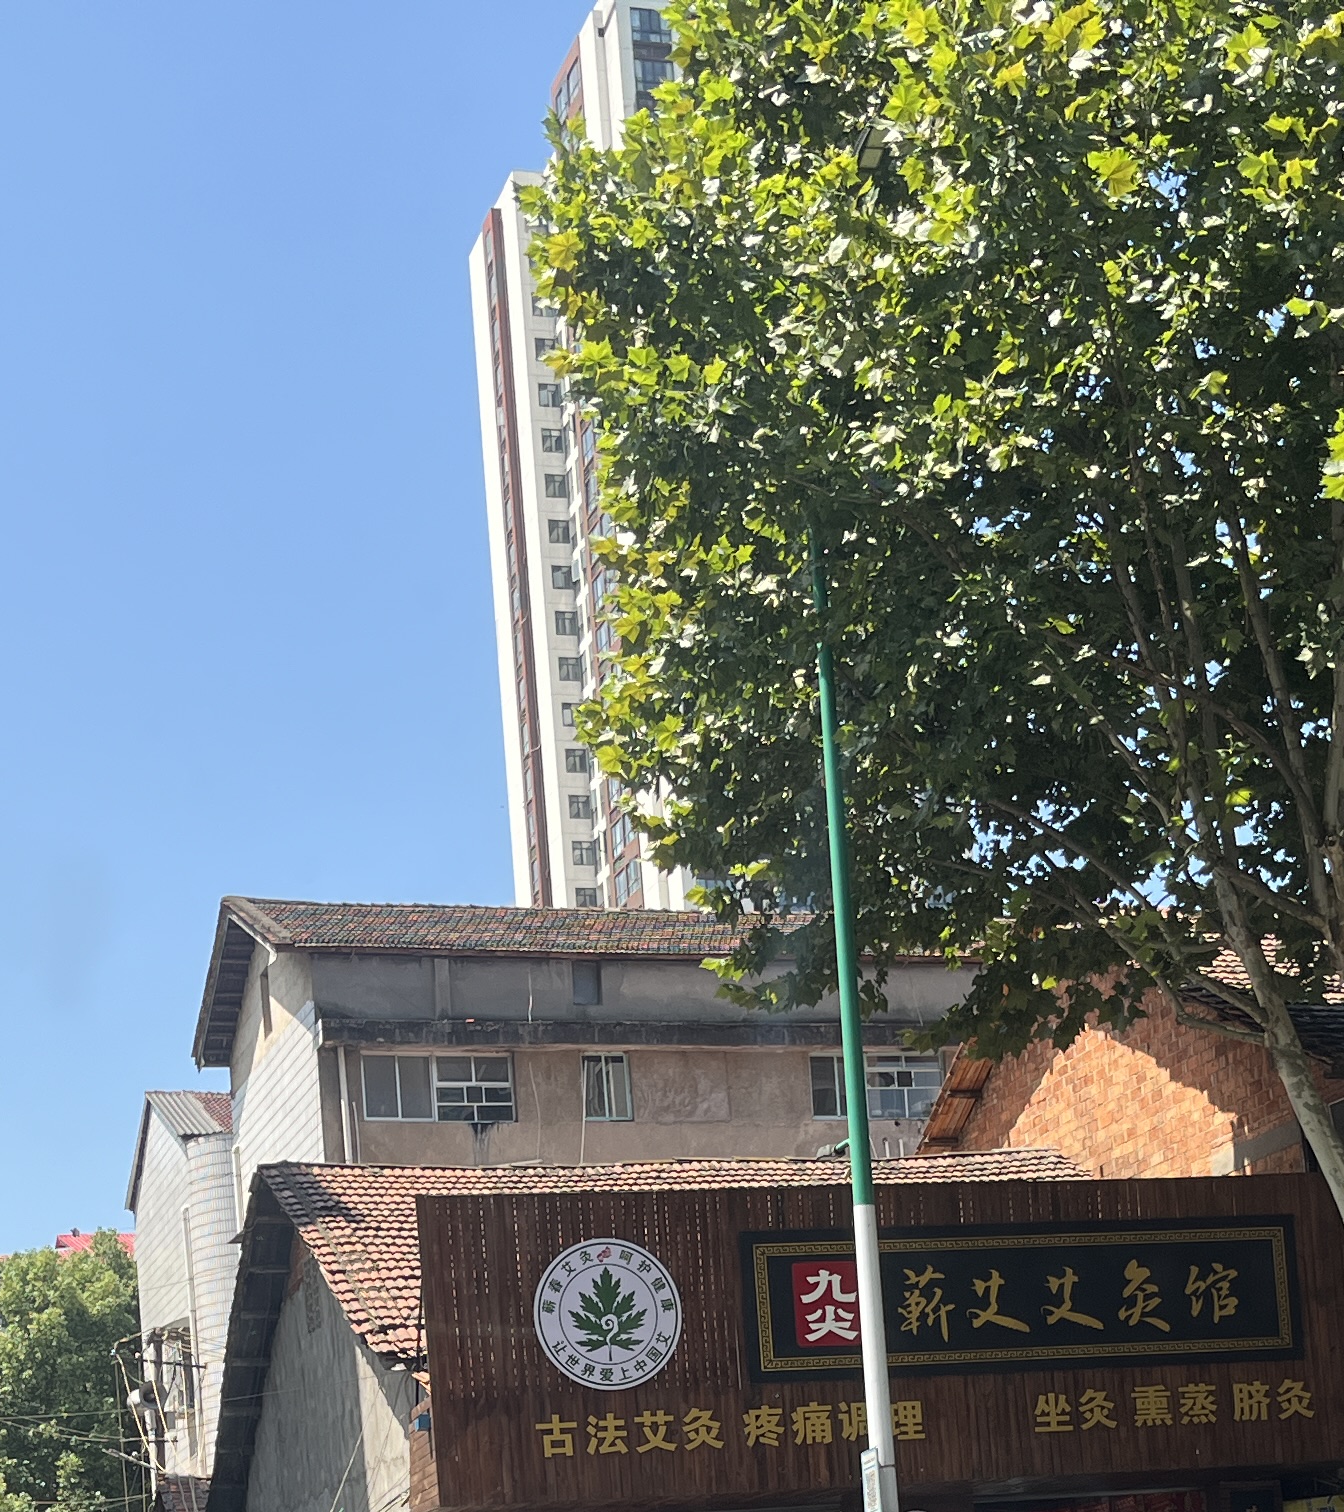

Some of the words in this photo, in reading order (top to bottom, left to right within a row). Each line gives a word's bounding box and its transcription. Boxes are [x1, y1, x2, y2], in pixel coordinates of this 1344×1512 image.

[551, 1331, 672, 1382] 让世界爱上中国艾
[535, 1407, 726, 1459] 古法艾灸
[743, 1400, 928, 1449] 疼痛调理
[1034, 1386, 1118, 1433] 坐灸
[1131, 1383, 1221, 1427] 熏蒸
[1231, 1376, 1317, 1422] 脐灸
